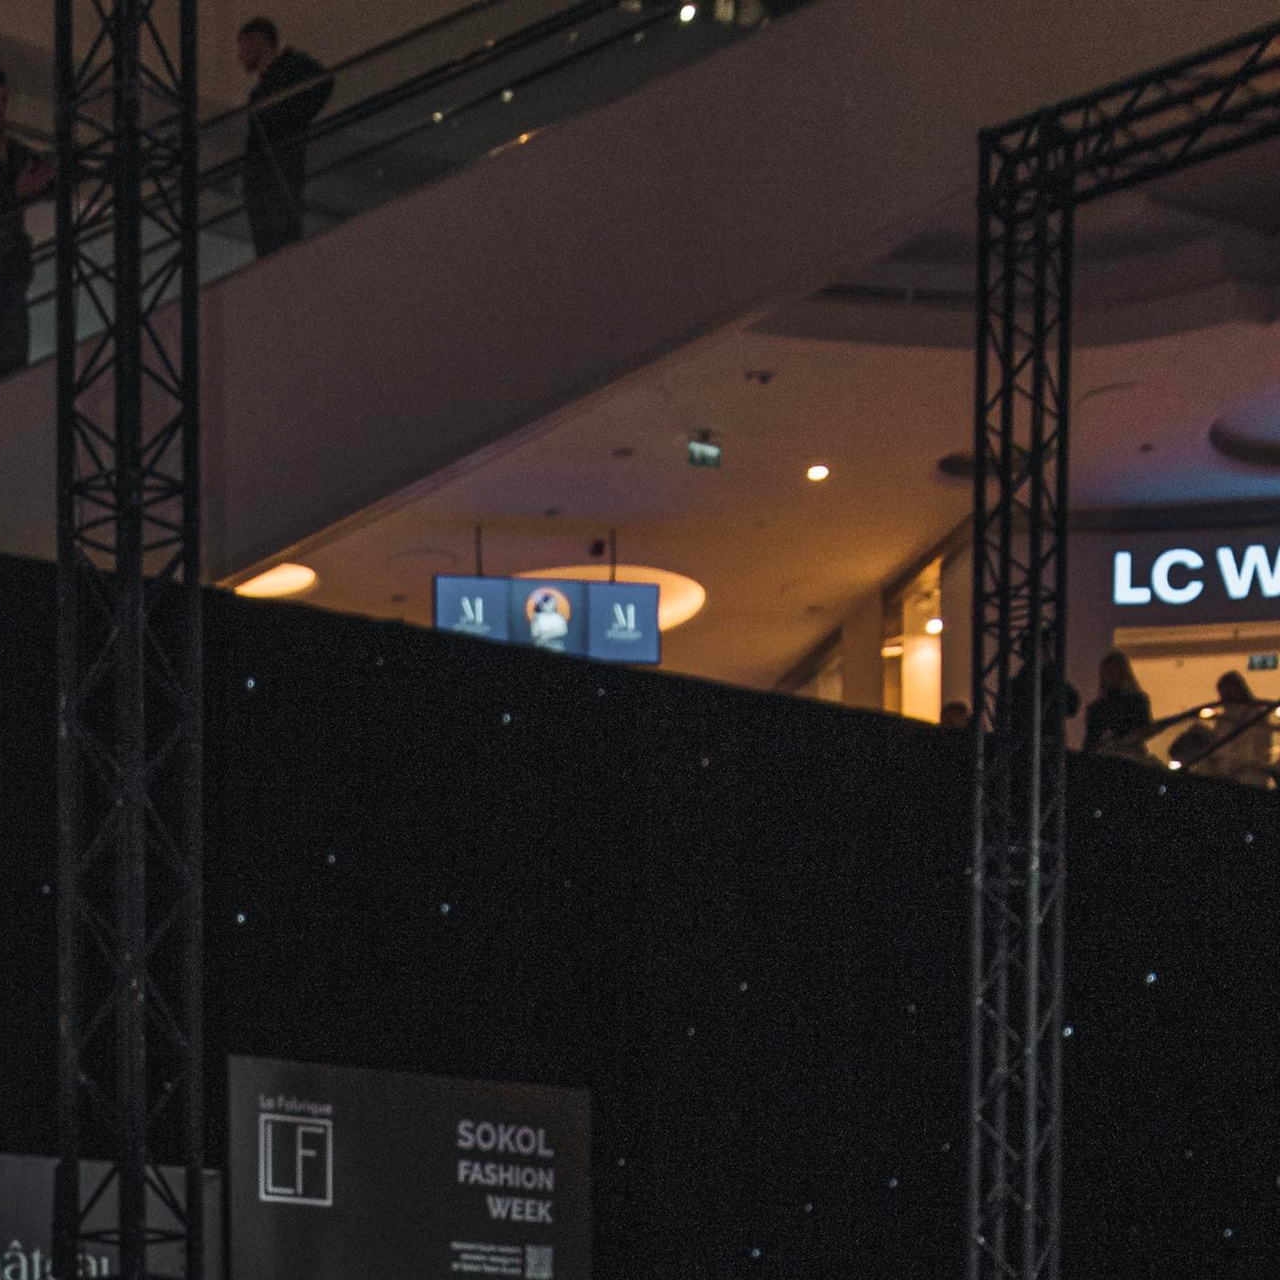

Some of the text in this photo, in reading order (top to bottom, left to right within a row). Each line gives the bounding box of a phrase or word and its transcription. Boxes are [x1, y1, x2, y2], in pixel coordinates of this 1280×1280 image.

[1114, 548, 1204, 605] LC
[457, 1119, 554, 1157] SOKOL
[458, 1159, 554, 1192] FASHION
[486, 1194, 553, 1223] WEEK
